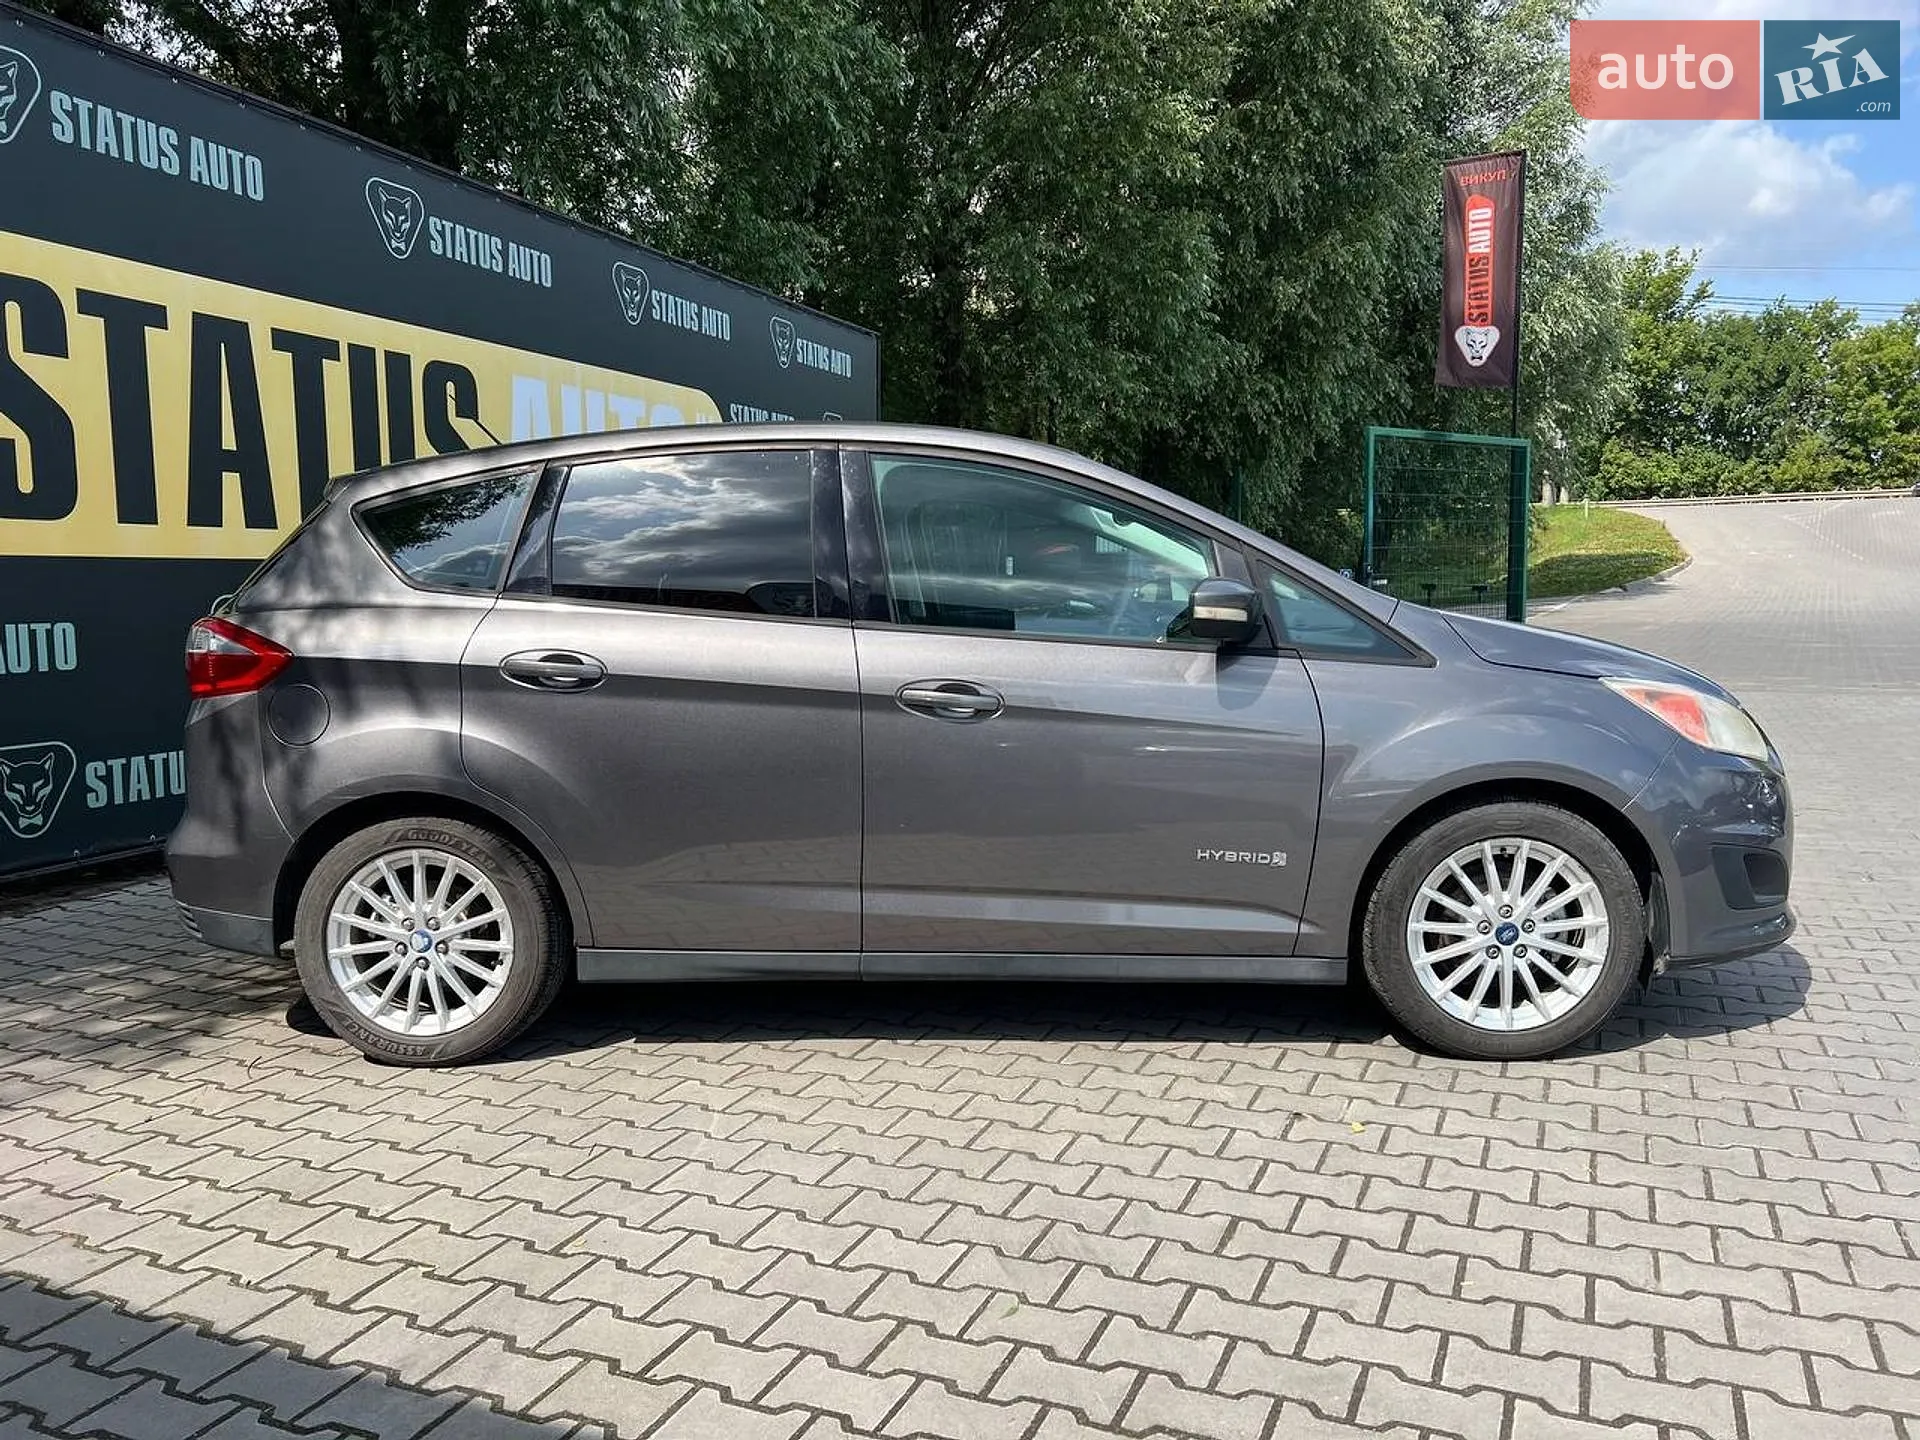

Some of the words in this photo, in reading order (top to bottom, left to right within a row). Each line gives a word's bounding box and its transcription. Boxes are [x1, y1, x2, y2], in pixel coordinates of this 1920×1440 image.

[50, 91, 180, 177] STATUS
[190, 137, 264, 201] AUTO
[429, 215, 503, 273] STATUS
[508, 242, 552, 288] AUTO
[1469, 208, 1492, 253] AUTO
[651, 289, 699, 331] STATUS
[702, 313, 731, 341] AUTO
[1468, 256, 1489, 322] STATUS
[796, 338, 830, 371] STATUS
[831, 352, 852, 378] AUTO
[0, 622, 78, 674] UTO
[1197, 849, 1270, 863] HYBRID
